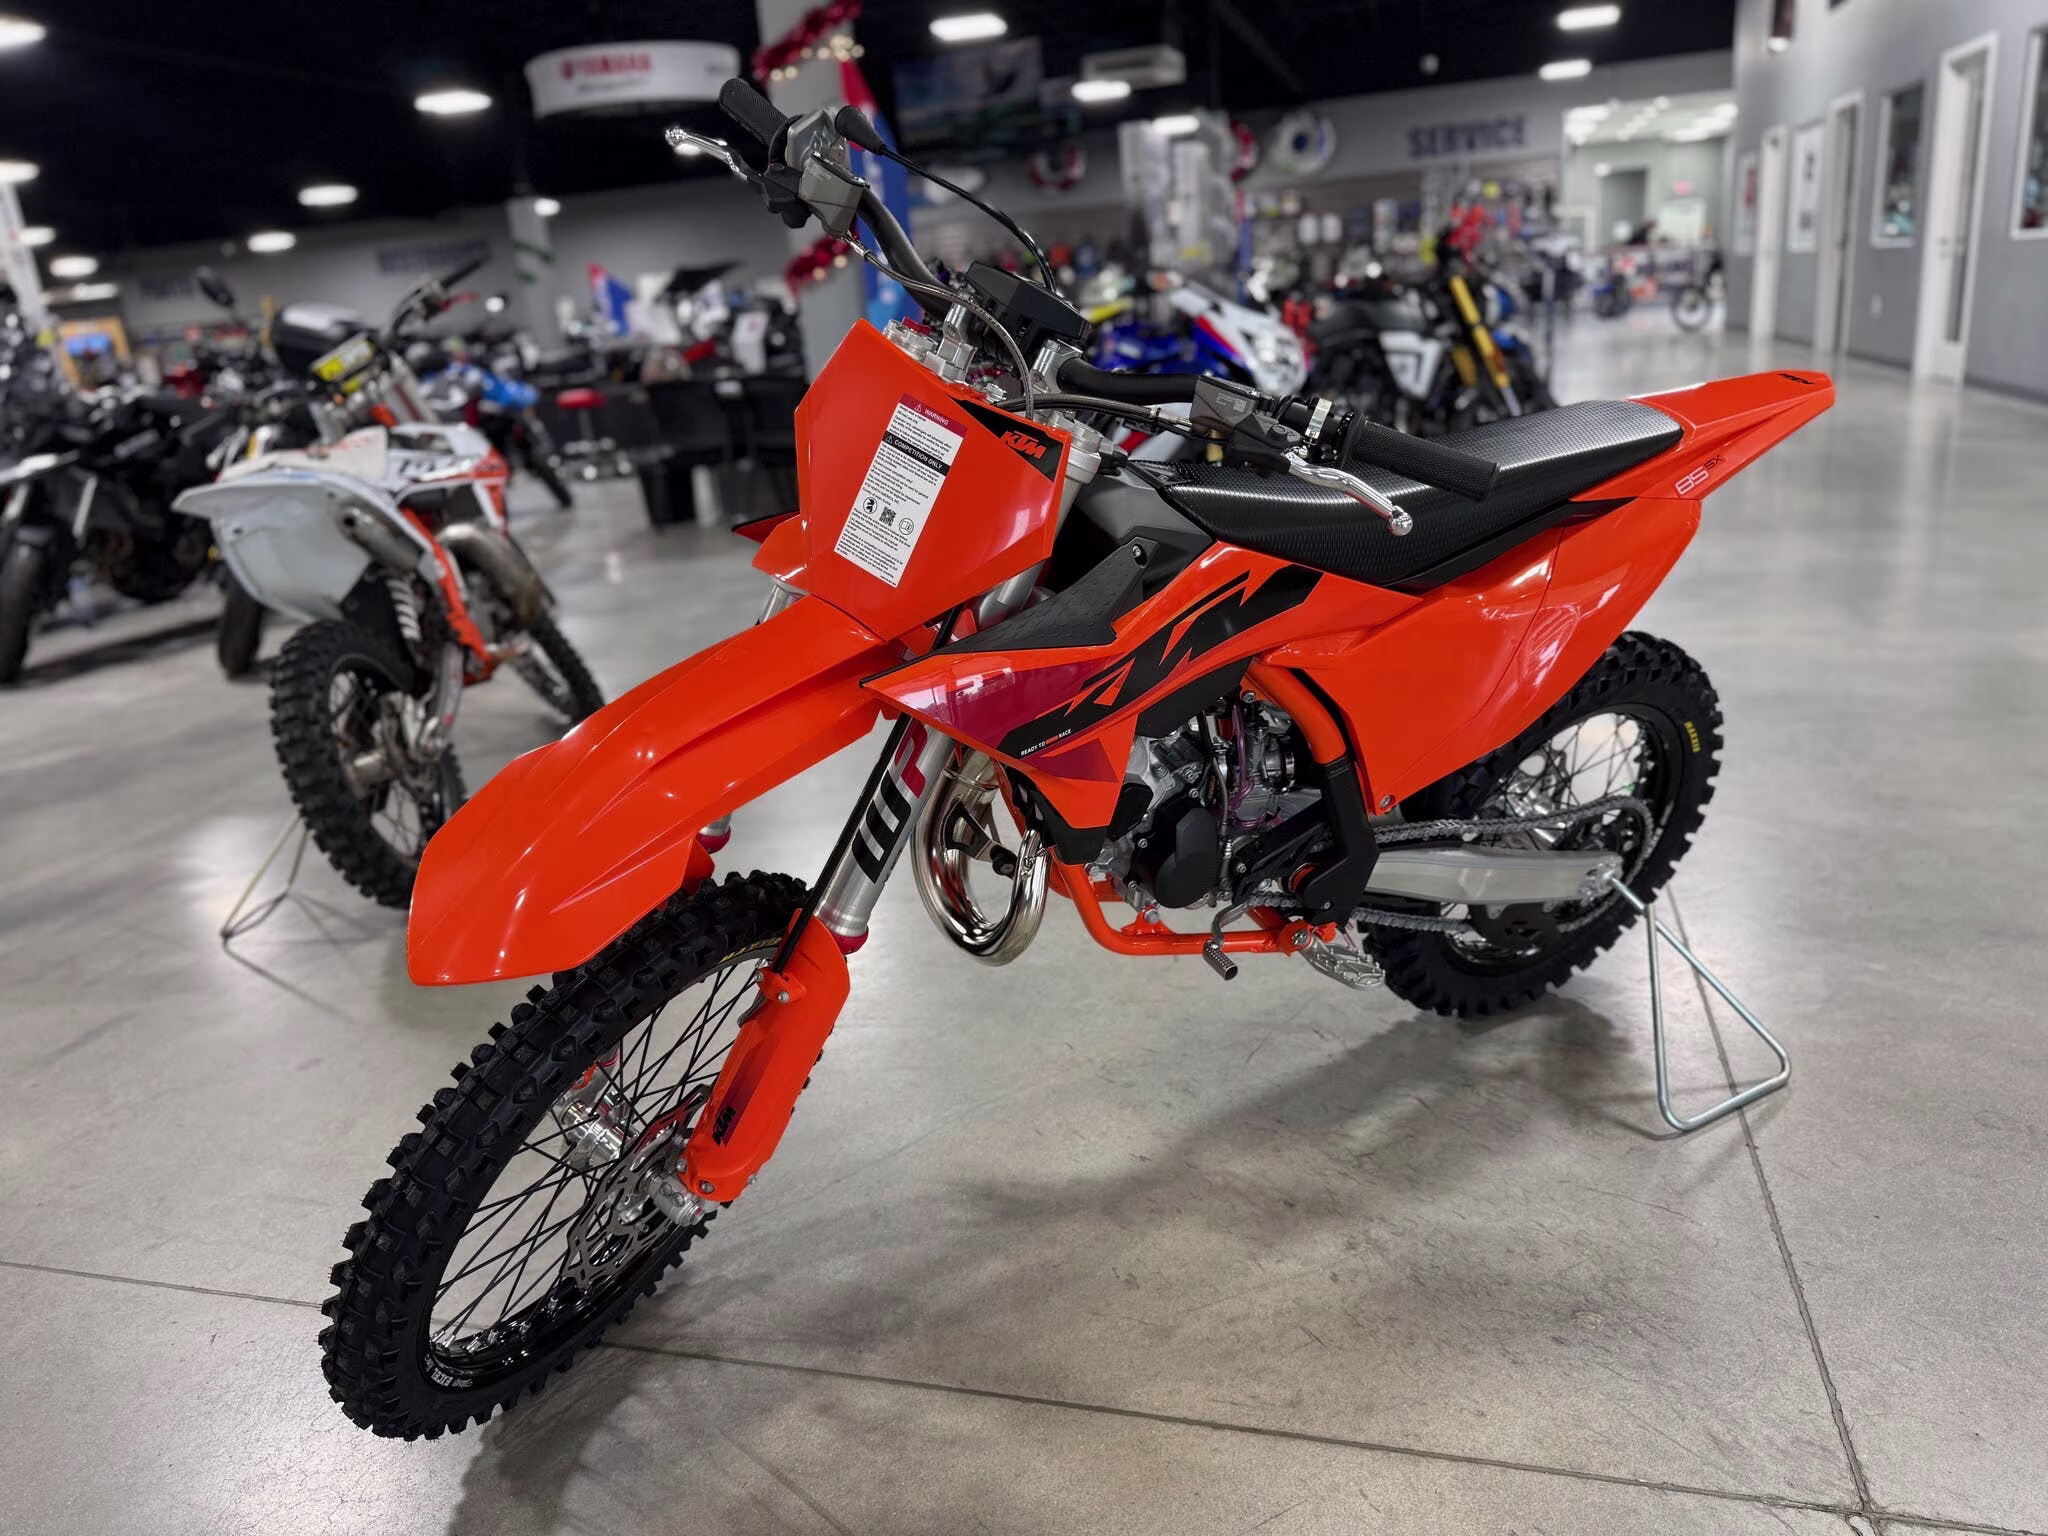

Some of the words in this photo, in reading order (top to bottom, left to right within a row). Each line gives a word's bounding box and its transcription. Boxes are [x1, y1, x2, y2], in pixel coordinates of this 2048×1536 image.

[1409, 115, 1525, 158] SERVICE
[926, 409, 948, 425] WARNING
[894, 439, 927, 461] COMPETITION
[928, 457, 942, 469] ONLY
[1000, 431, 1047, 459] KTM
[1675, 466, 1709, 495] 85
[1704, 454, 1724, 471] SX
[1000, 565, 1326, 757] KTM
[1020, 744, 1038, 756] READY
[1058, 728, 1071, 738] RACE
[852, 716, 928, 883] WP
[712, 1105, 737, 1146] KTM
[431, 1368, 452, 1387] EXCEL
